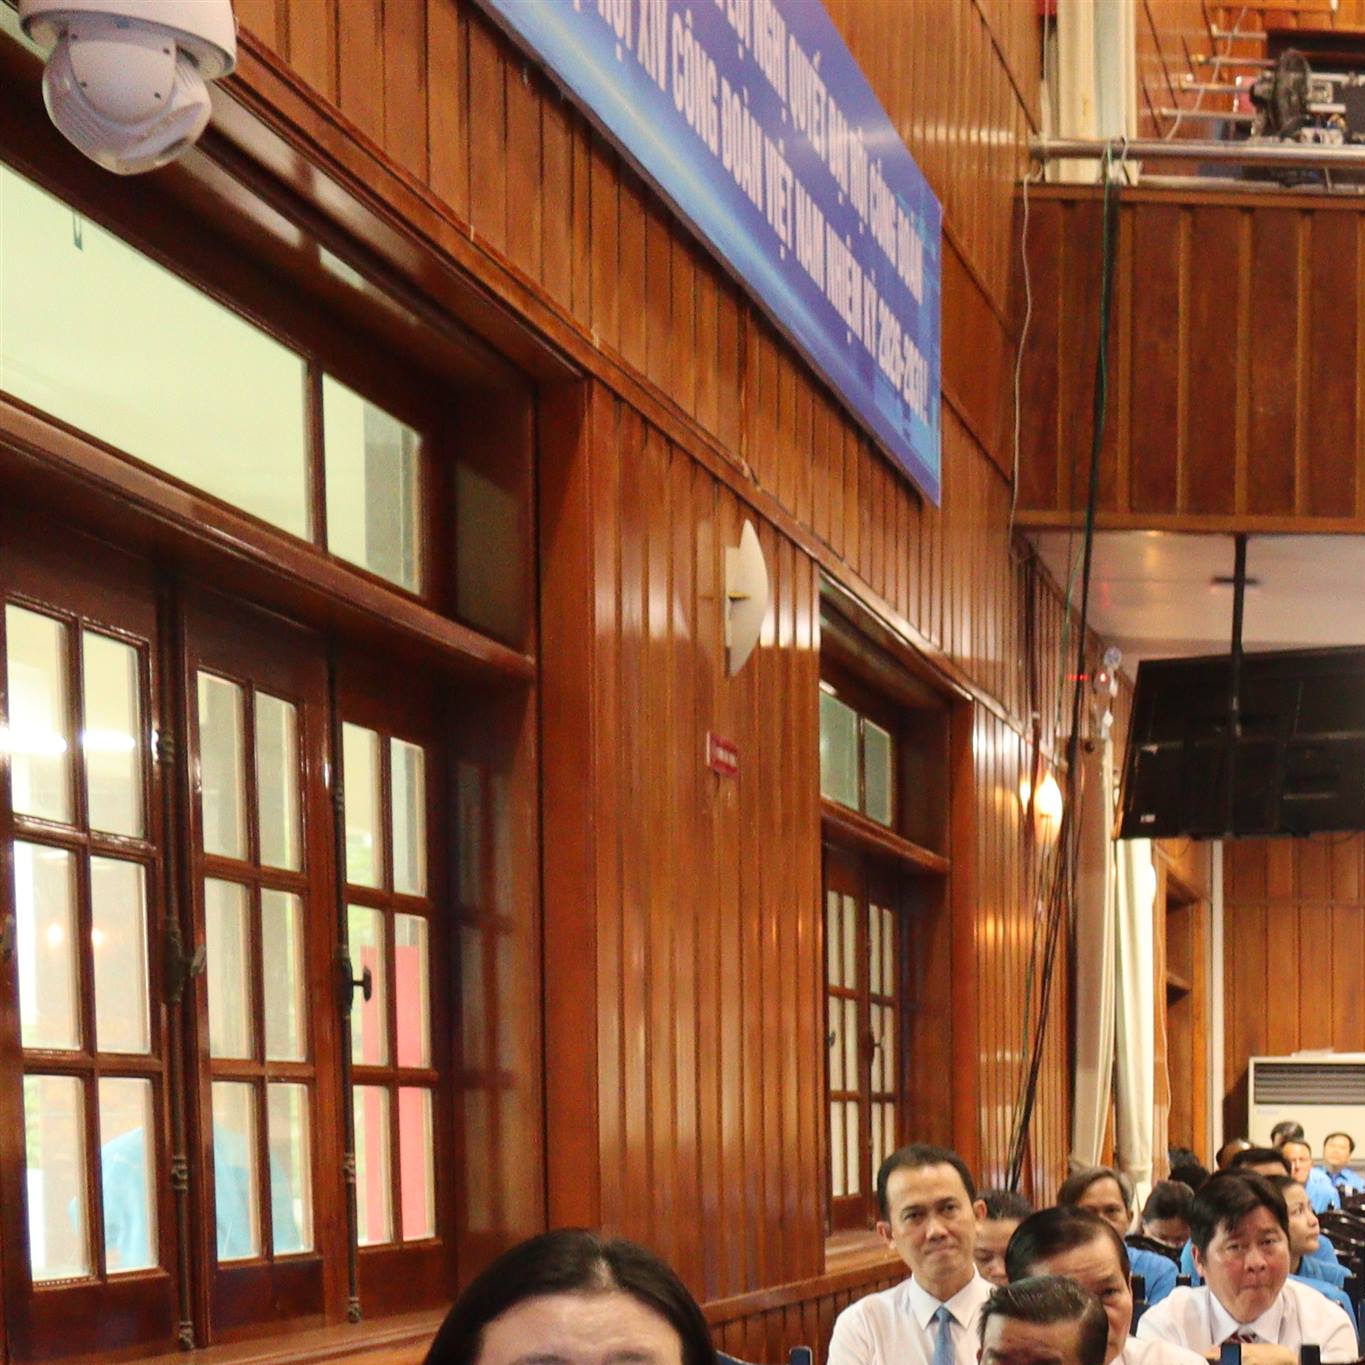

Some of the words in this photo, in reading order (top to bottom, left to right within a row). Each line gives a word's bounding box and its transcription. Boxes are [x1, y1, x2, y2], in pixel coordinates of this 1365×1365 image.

[672, 9, 719, 157] CÔNG
[721, 76, 763, 213] ĐOÀN
[765, 135, 793, 261] VIỆT
[795, 177, 825, 293] NAM
[826, 221, 863, 346] NHIỆM
[789, 33, 827, 162] QUYẾT
